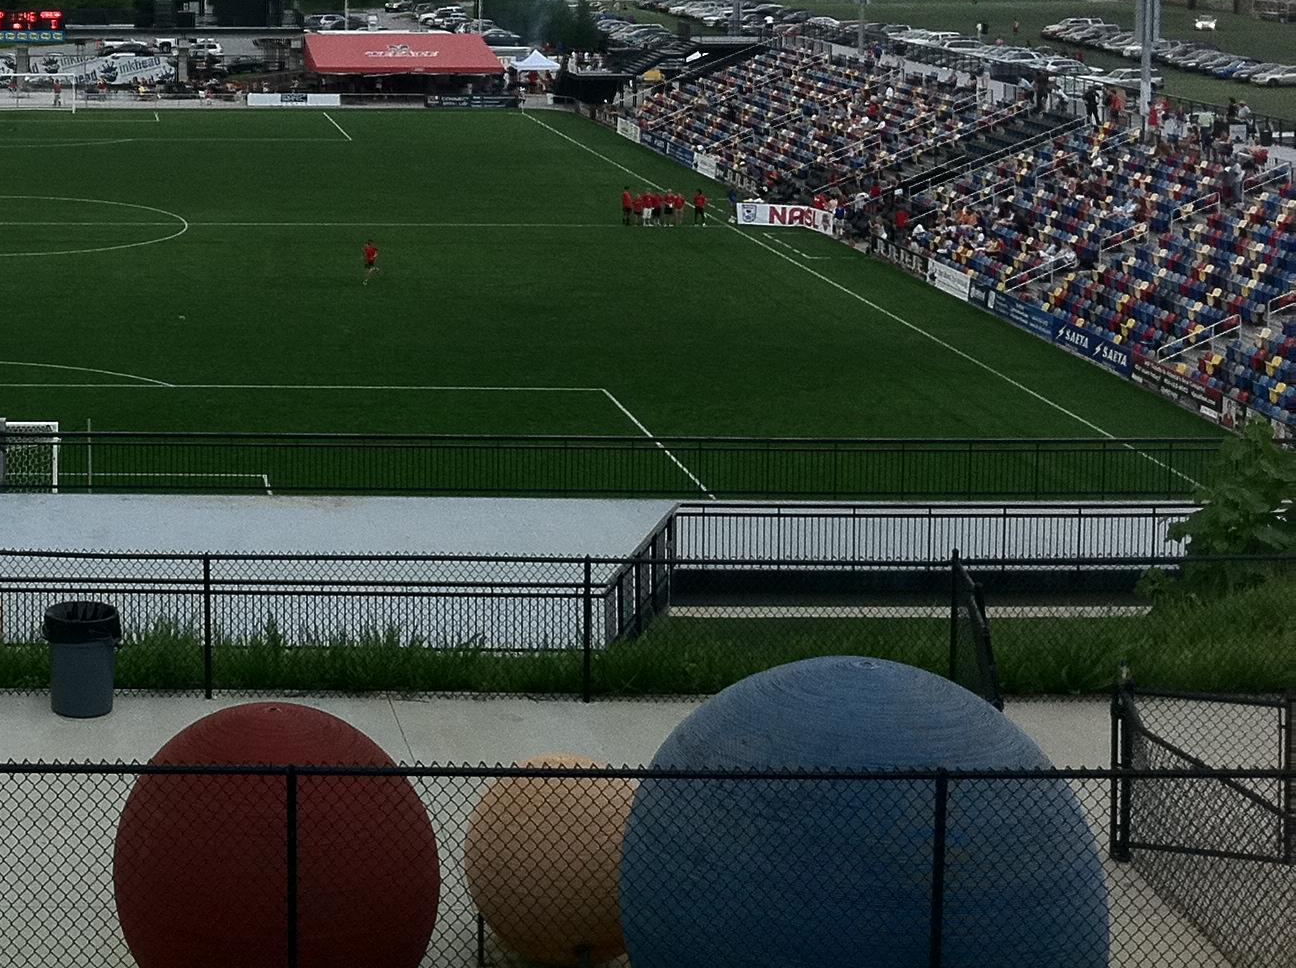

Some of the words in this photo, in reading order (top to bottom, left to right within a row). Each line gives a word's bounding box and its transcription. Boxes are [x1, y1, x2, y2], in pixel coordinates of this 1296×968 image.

[118, 57, 161, 75] inkhead
[768, 206, 818, 229] NASL
[1064, 328, 1089, 349] SAETA
[1102, 346, 1128, 367] SAETA
